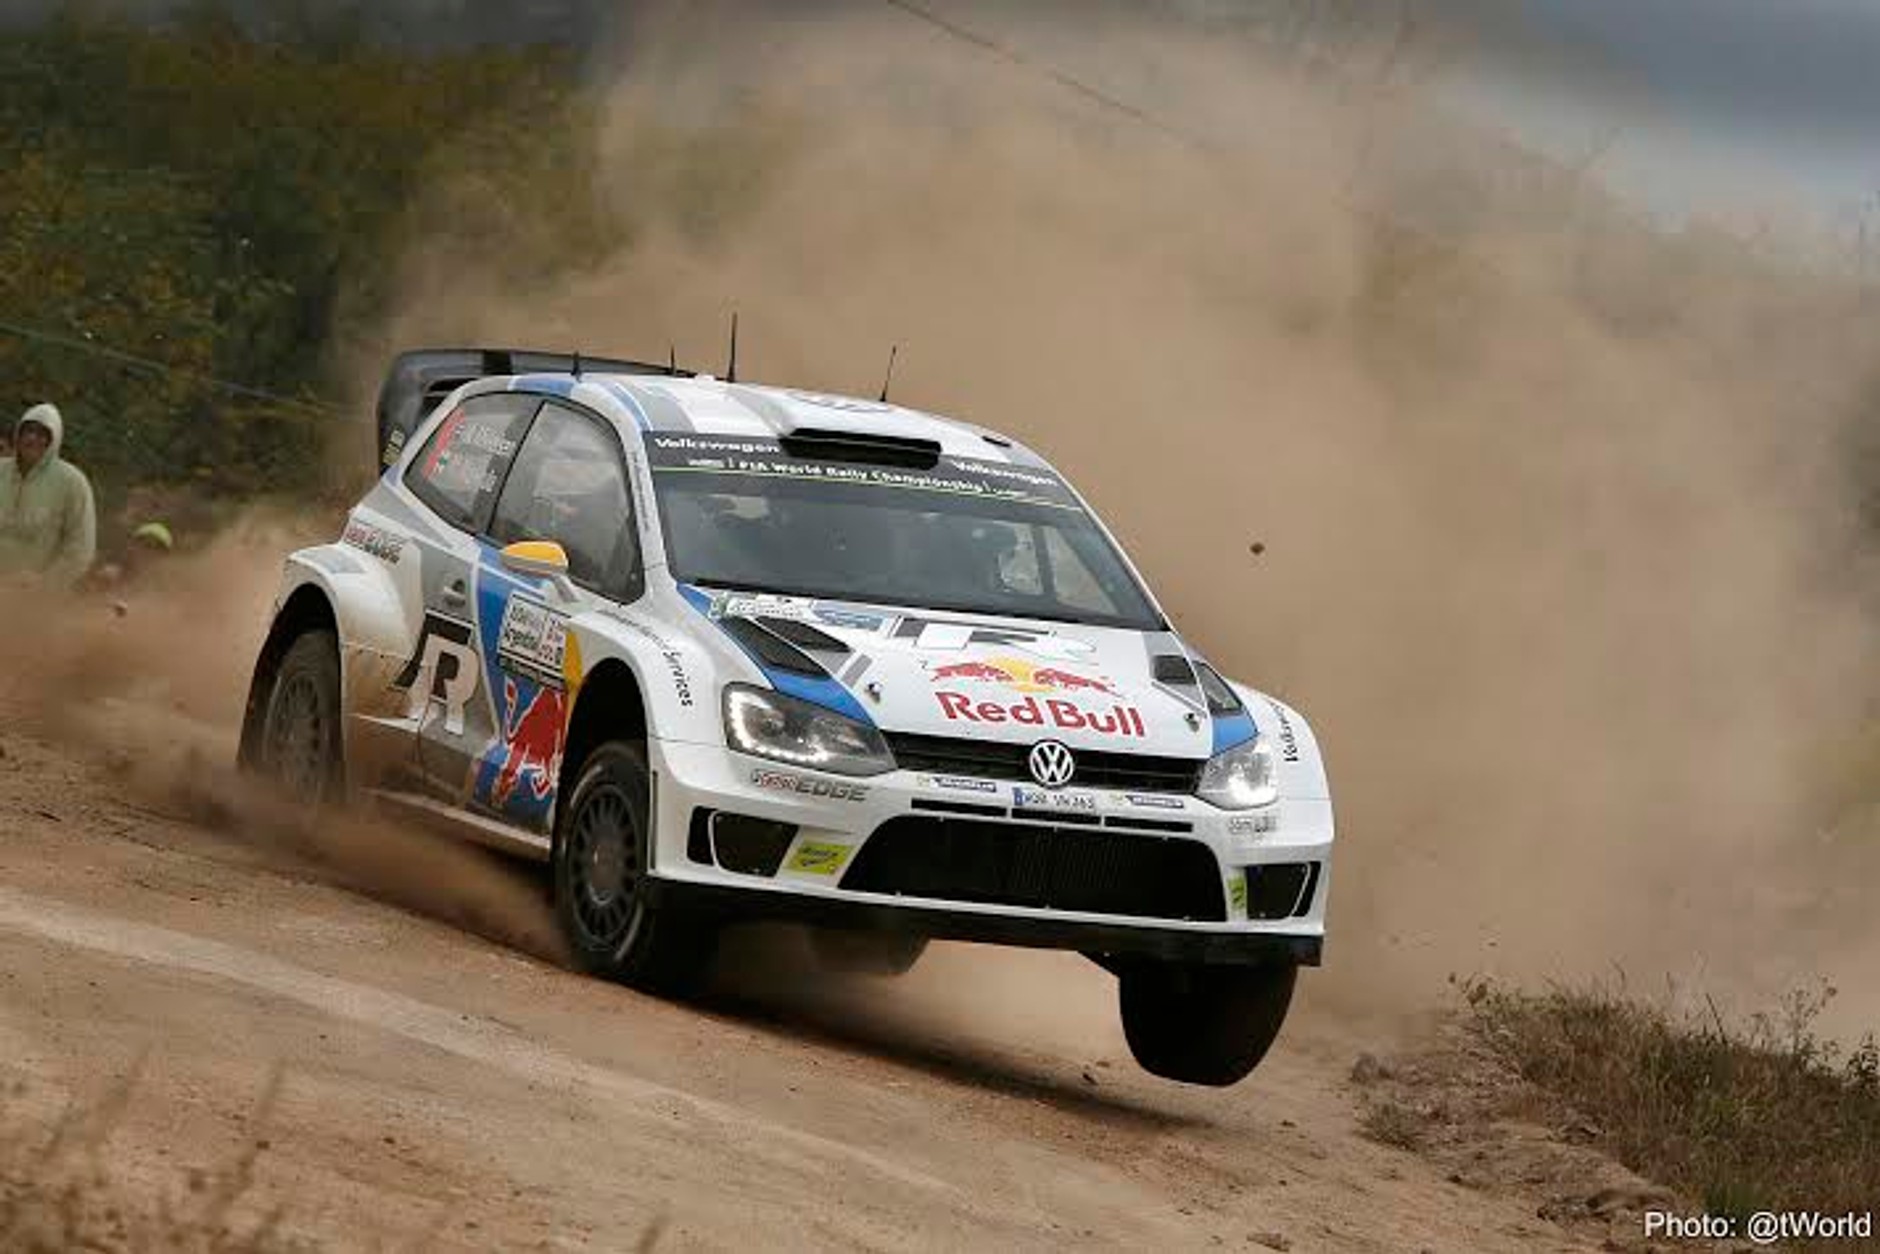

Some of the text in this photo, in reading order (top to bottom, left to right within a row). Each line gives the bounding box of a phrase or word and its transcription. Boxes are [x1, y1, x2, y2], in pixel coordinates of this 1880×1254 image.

[935, 692, 1145, 737] Red Bull
[796, 779, 871, 802] EDGE
